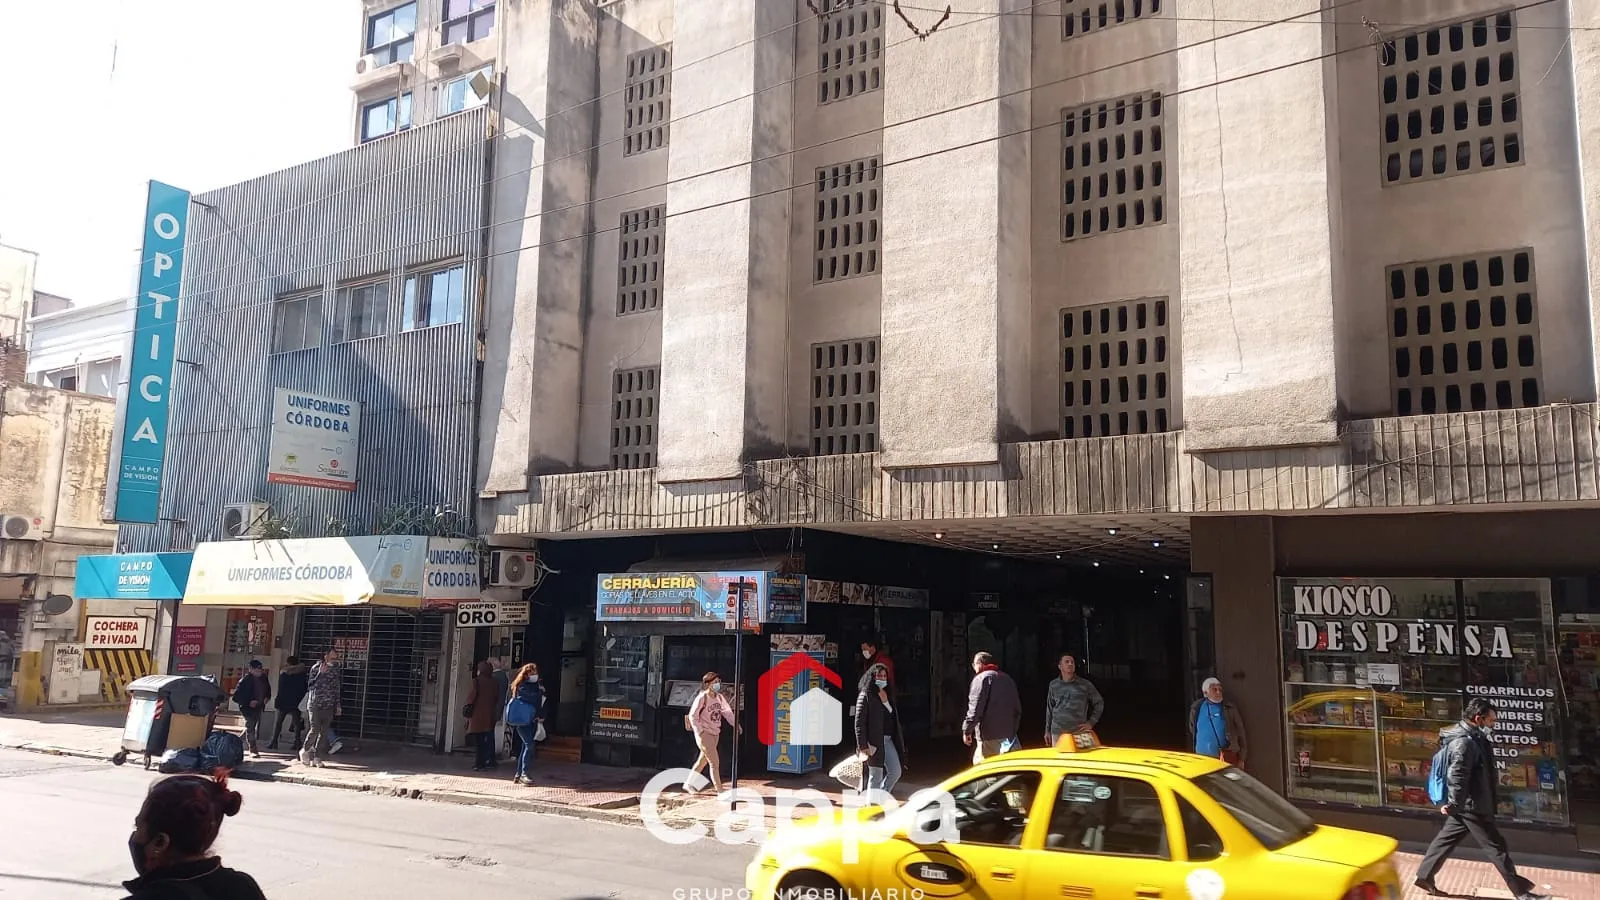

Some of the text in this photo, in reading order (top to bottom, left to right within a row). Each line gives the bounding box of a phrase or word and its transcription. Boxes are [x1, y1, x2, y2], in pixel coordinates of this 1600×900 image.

[132, 212, 180, 444] OPTICA
[287, 394, 350, 416] UNIFORMES
[286, 410, 349, 433] CÓRDOBA
[124, 464, 159, 473] CAMPO
[429, 549, 476, 565] UNIFORMES
[120, 561, 153, 572] CAMPO
[228, 563, 352, 581] UNIFORMES CÓRDOBA
[118, 576, 127, 585] DE
[427, 568, 477, 587] CÓRDOBA
[602, 575, 696, 590] CERRAJERÍA
[679, 590, 696, 598] ACTO
[1293, 586, 1392, 616] KIOSCO
[605, 606, 691, 614] TRABAJOS A DOMICILIO
[458, 611, 496, 624] ORO
[94, 621, 138, 632] COCHERA
[92, 634, 138, 645] PRIVADA
[1296, 620, 1513, 658] DESPENSA
[176, 643, 200, 655] $1999
[1466, 685, 1554, 697] CIGARRILLOS
[1489, 698, 1544, 710] NDWICH
[1497, 711, 1543, 722] MBRES
[1493, 722, 1533, 733] BIDAS
[1486, 734, 1539, 745] ACTEOS
[1493, 747, 1518, 757] ELO
